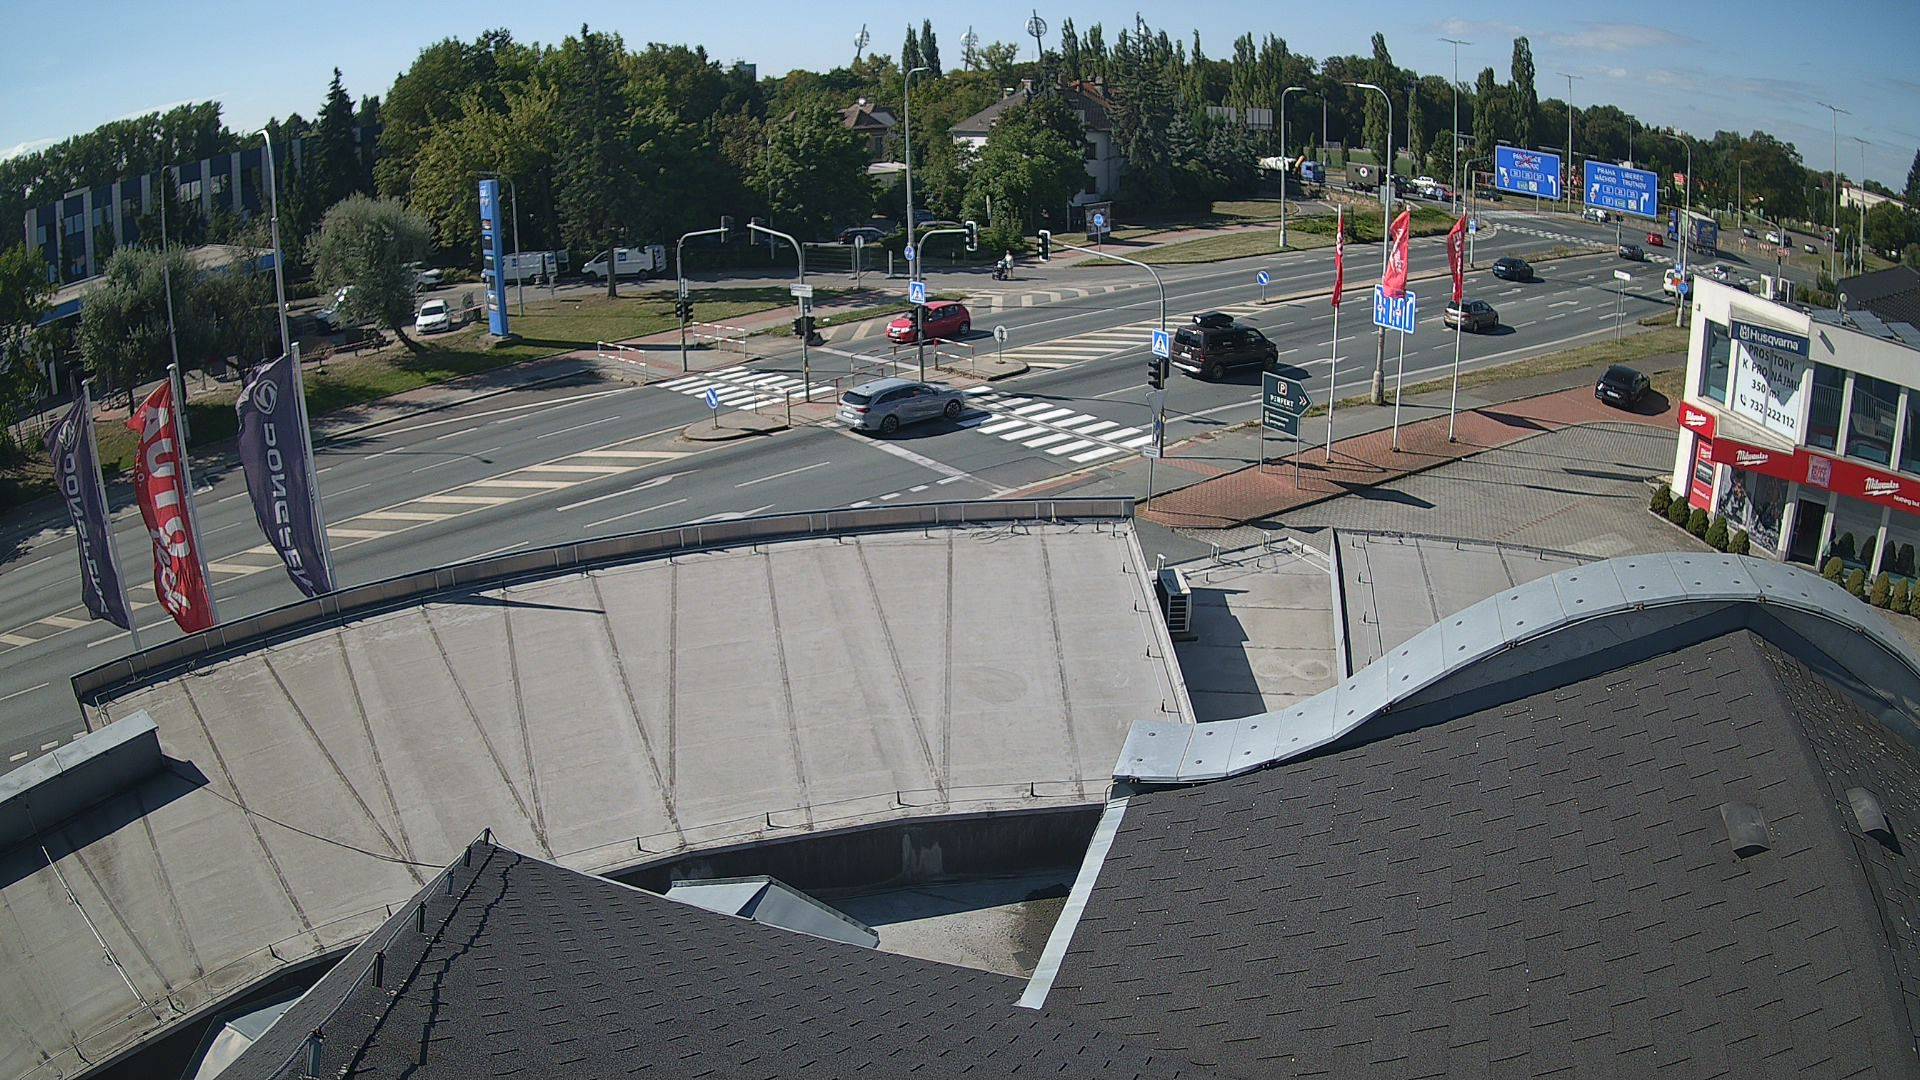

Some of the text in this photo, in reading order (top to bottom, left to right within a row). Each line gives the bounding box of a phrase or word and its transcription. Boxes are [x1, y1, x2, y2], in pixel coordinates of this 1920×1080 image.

[1597, 167, 1616, 177] PRAHA
[1621, 171, 1644, 181] LIBEREC
[1622, 178, 1647, 190] TRUTNOV
[1750, 329, 1798, 351] Husqvarna
[1742, 359, 1749, 371] K
[1751, 379, 1766, 394] 350
[1750, 399, 1795, 429] 732 222 112
[1736, 449, 1769, 462] Milwaukee
[143, 406, 191, 559] AUTO
[1864, 477, 1899, 491] Milwaukee
